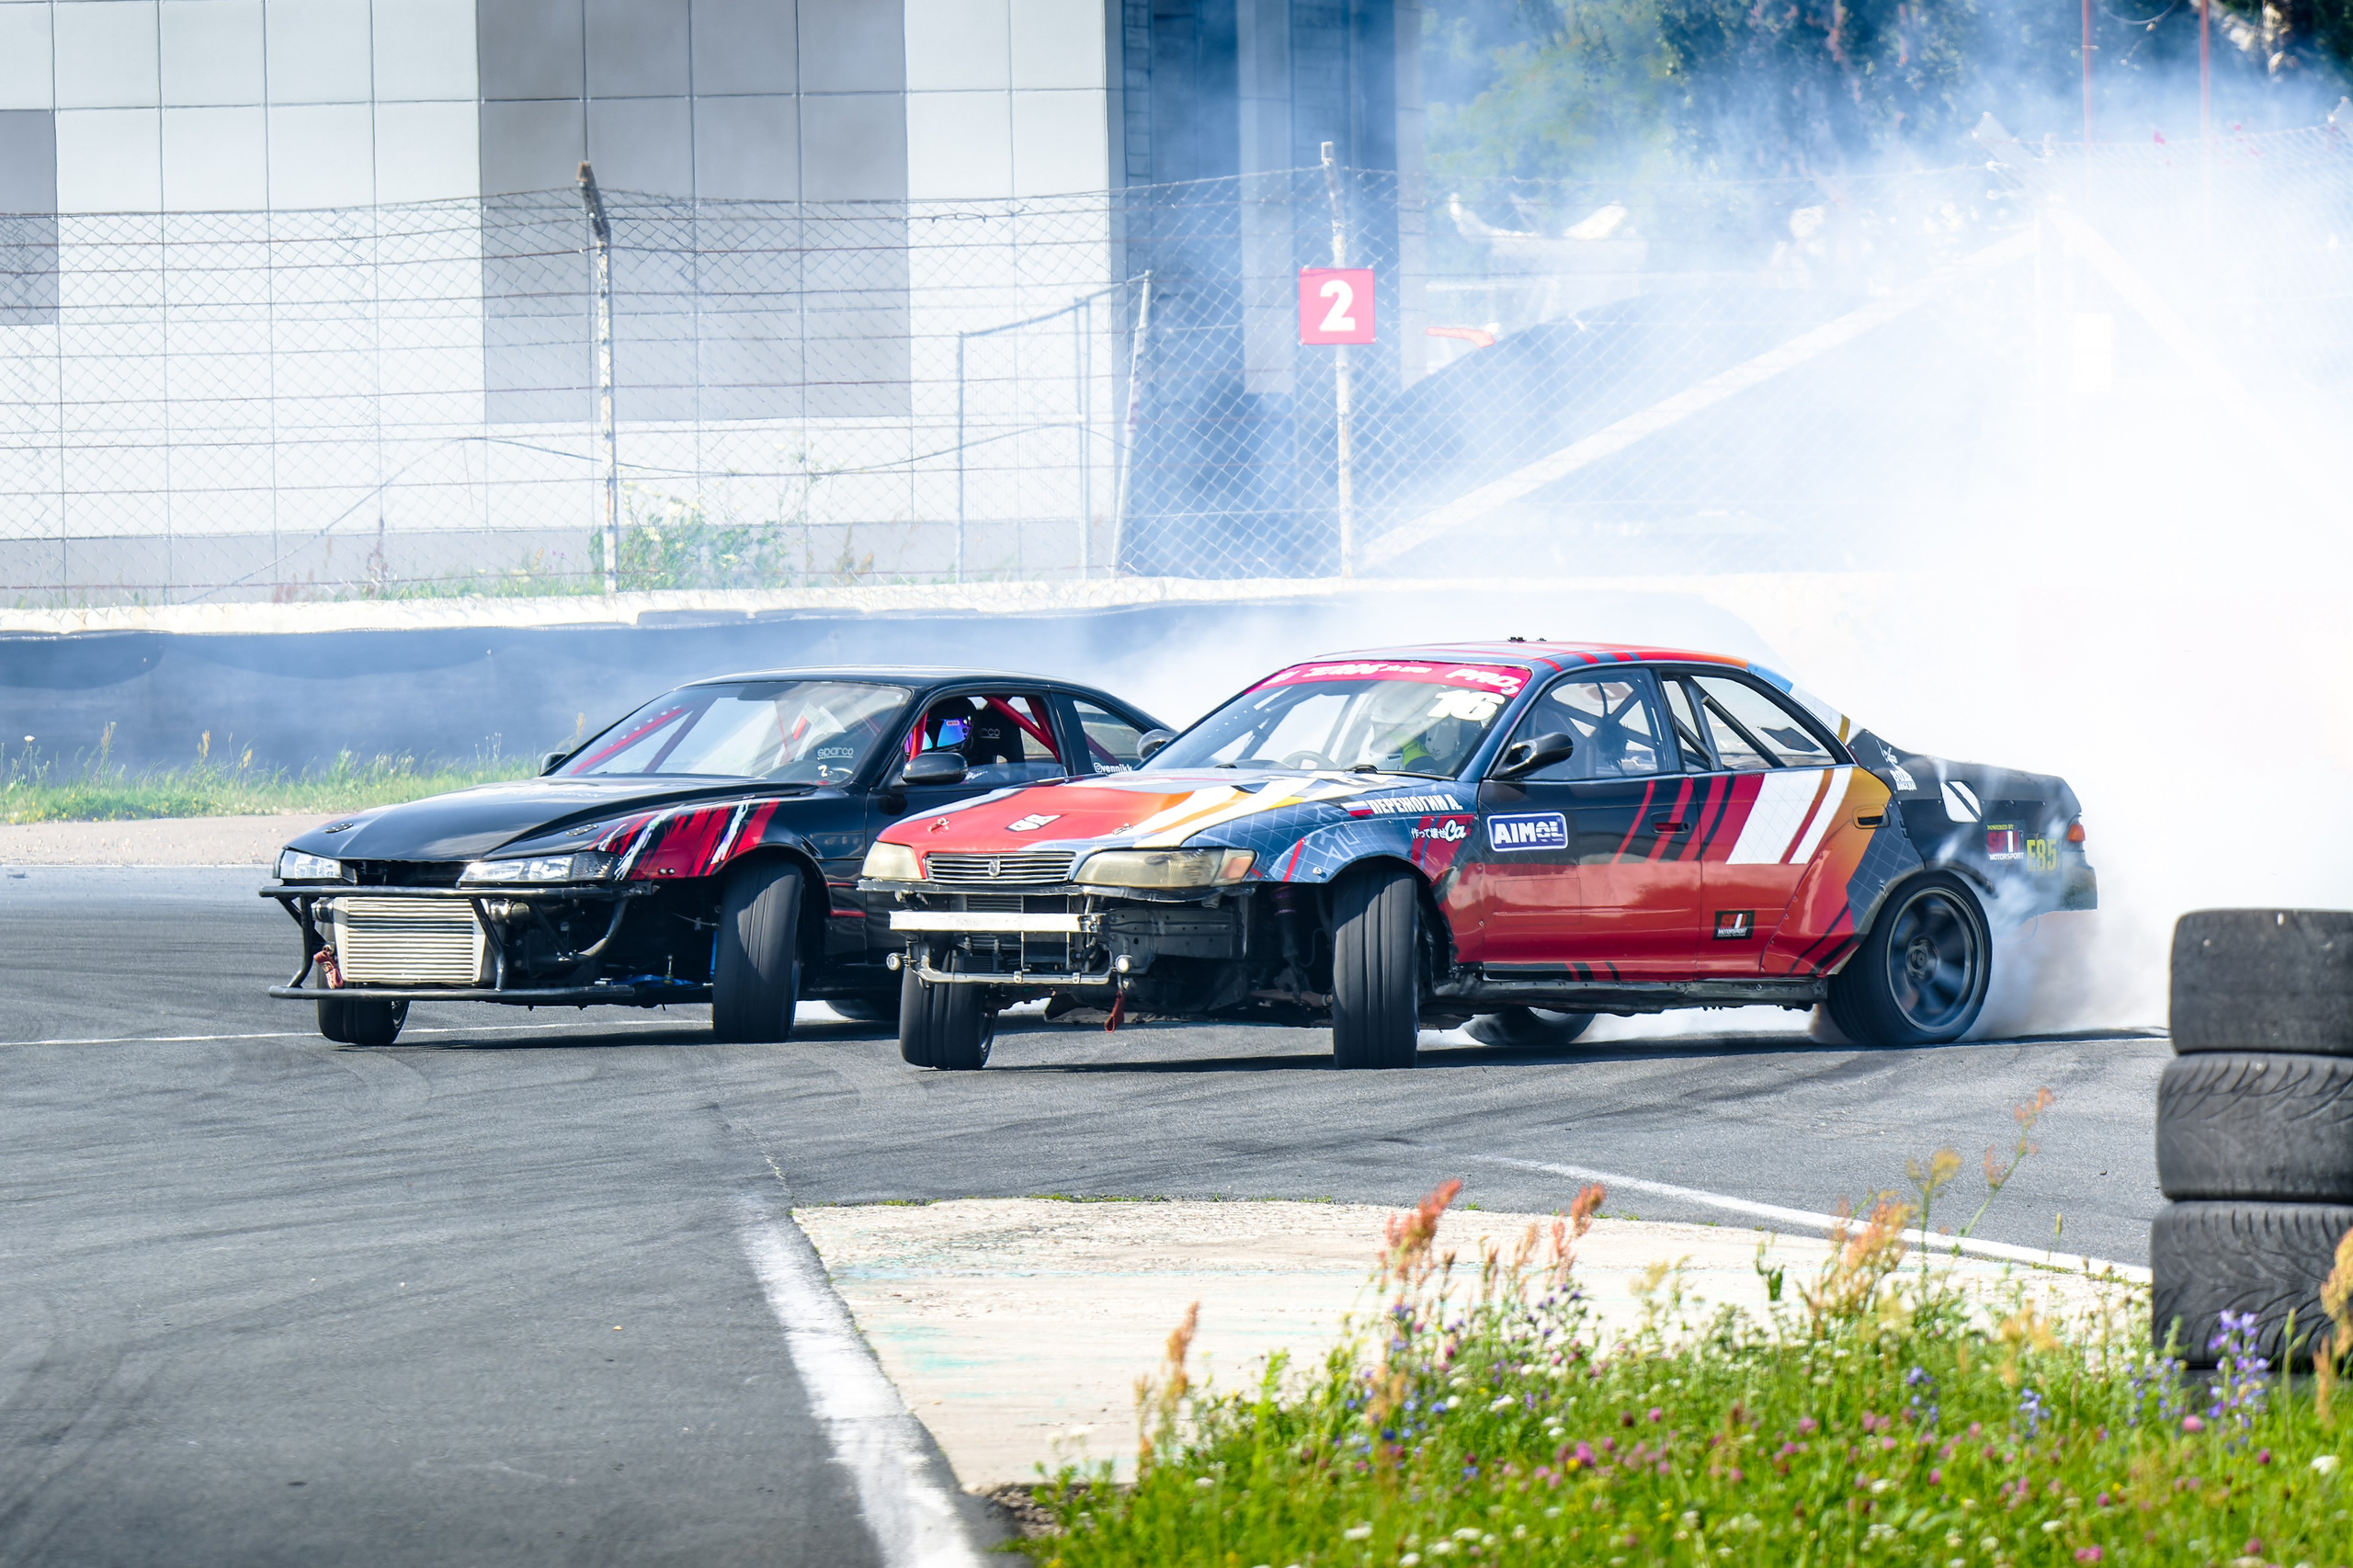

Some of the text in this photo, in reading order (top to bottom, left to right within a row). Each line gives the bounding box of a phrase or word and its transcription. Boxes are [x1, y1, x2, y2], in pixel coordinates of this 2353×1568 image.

[1319, 279, 1356, 331] 2
[1445, 668, 1522, 687] PRO
[1427, 689, 1506, 722] 16
[817, 747, 854, 759] sparco
[1494, 821, 1564, 845] AIMOL
[1989, 852, 2025, 861] MOTORSPORT
[2027, 838, 2058, 872] E85
